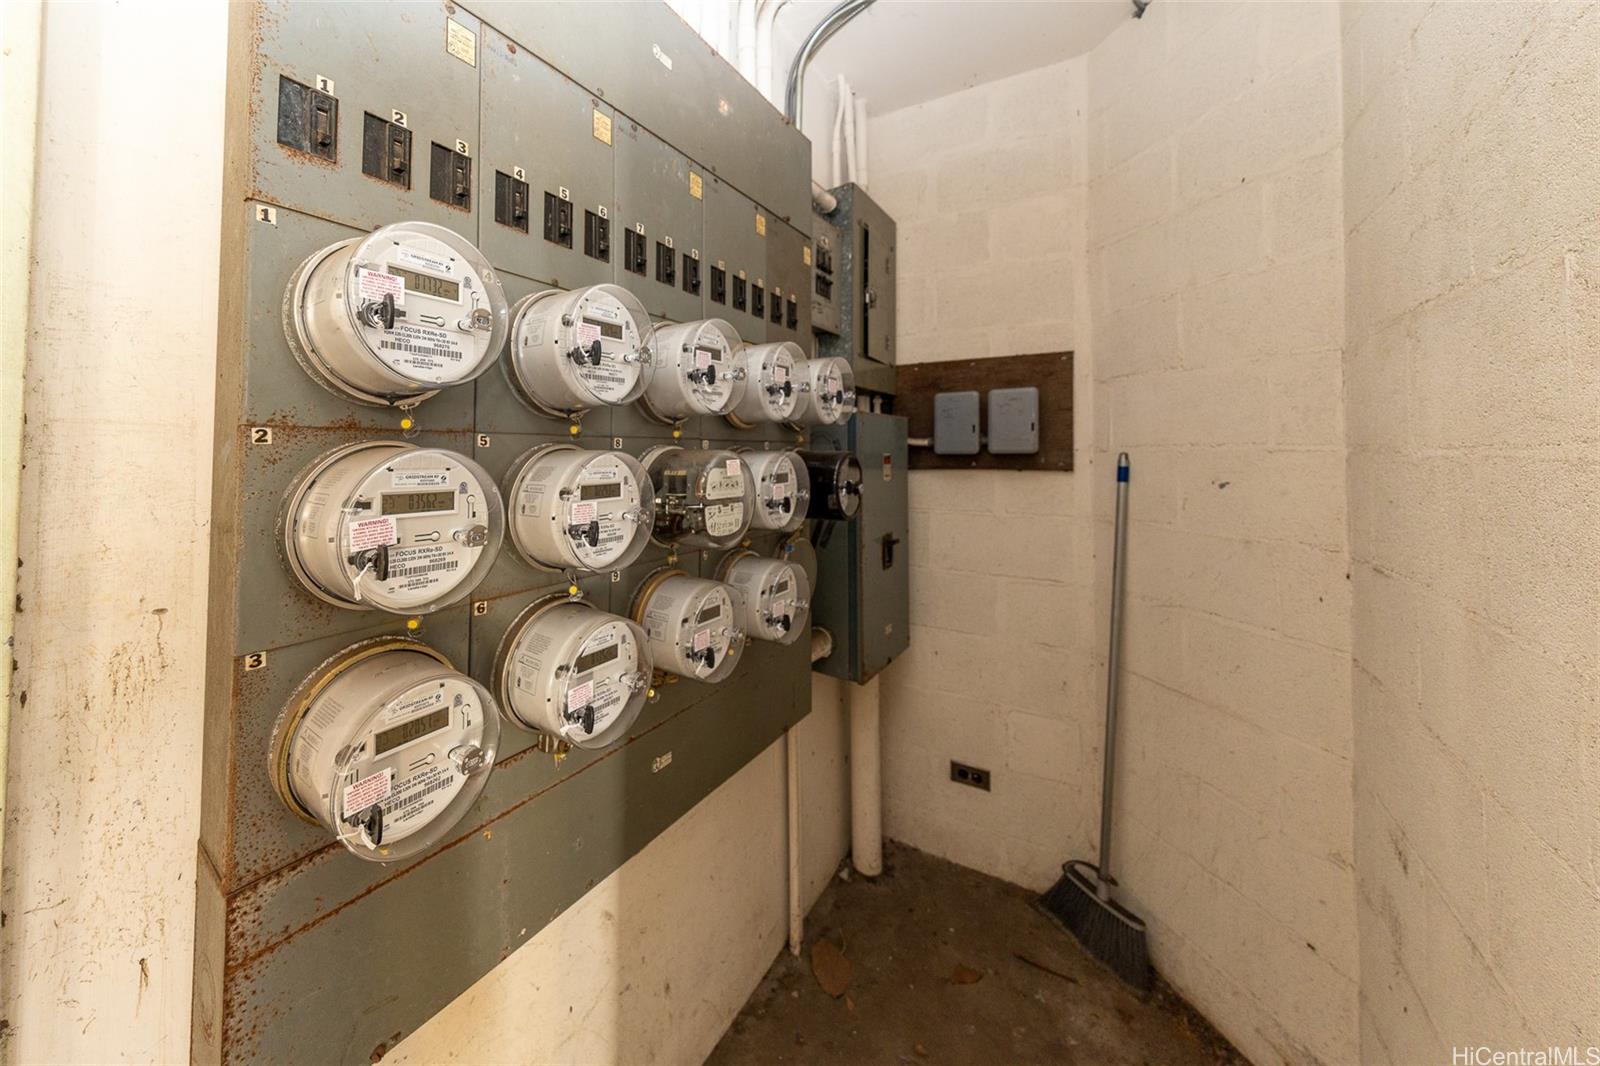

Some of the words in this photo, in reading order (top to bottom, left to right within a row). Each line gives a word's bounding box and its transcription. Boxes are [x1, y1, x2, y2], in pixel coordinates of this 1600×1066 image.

[320, 79, 330, 93] 1
[394, 112, 404, 125] 2
[458, 142, 467, 154] 3
[516, 169, 524, 180] 4
[562, 190, 568, 199] 5
[261, 208, 271, 223] 1
[600, 208, 606, 217] 6
[637, 224, 644, 233] 7
[254, 428, 268, 443] 2
[480, 436, 488, 446] 5
[616, 438, 621, 448] 8
[358, 518, 388, 528] WARNING!
[396, 550, 416, 558] FOCUS
[614, 572, 619, 580] 9
[477, 602, 486, 614] 6
[249, 653, 262, 668] 3
[352, 772, 384, 790] WARNING!
